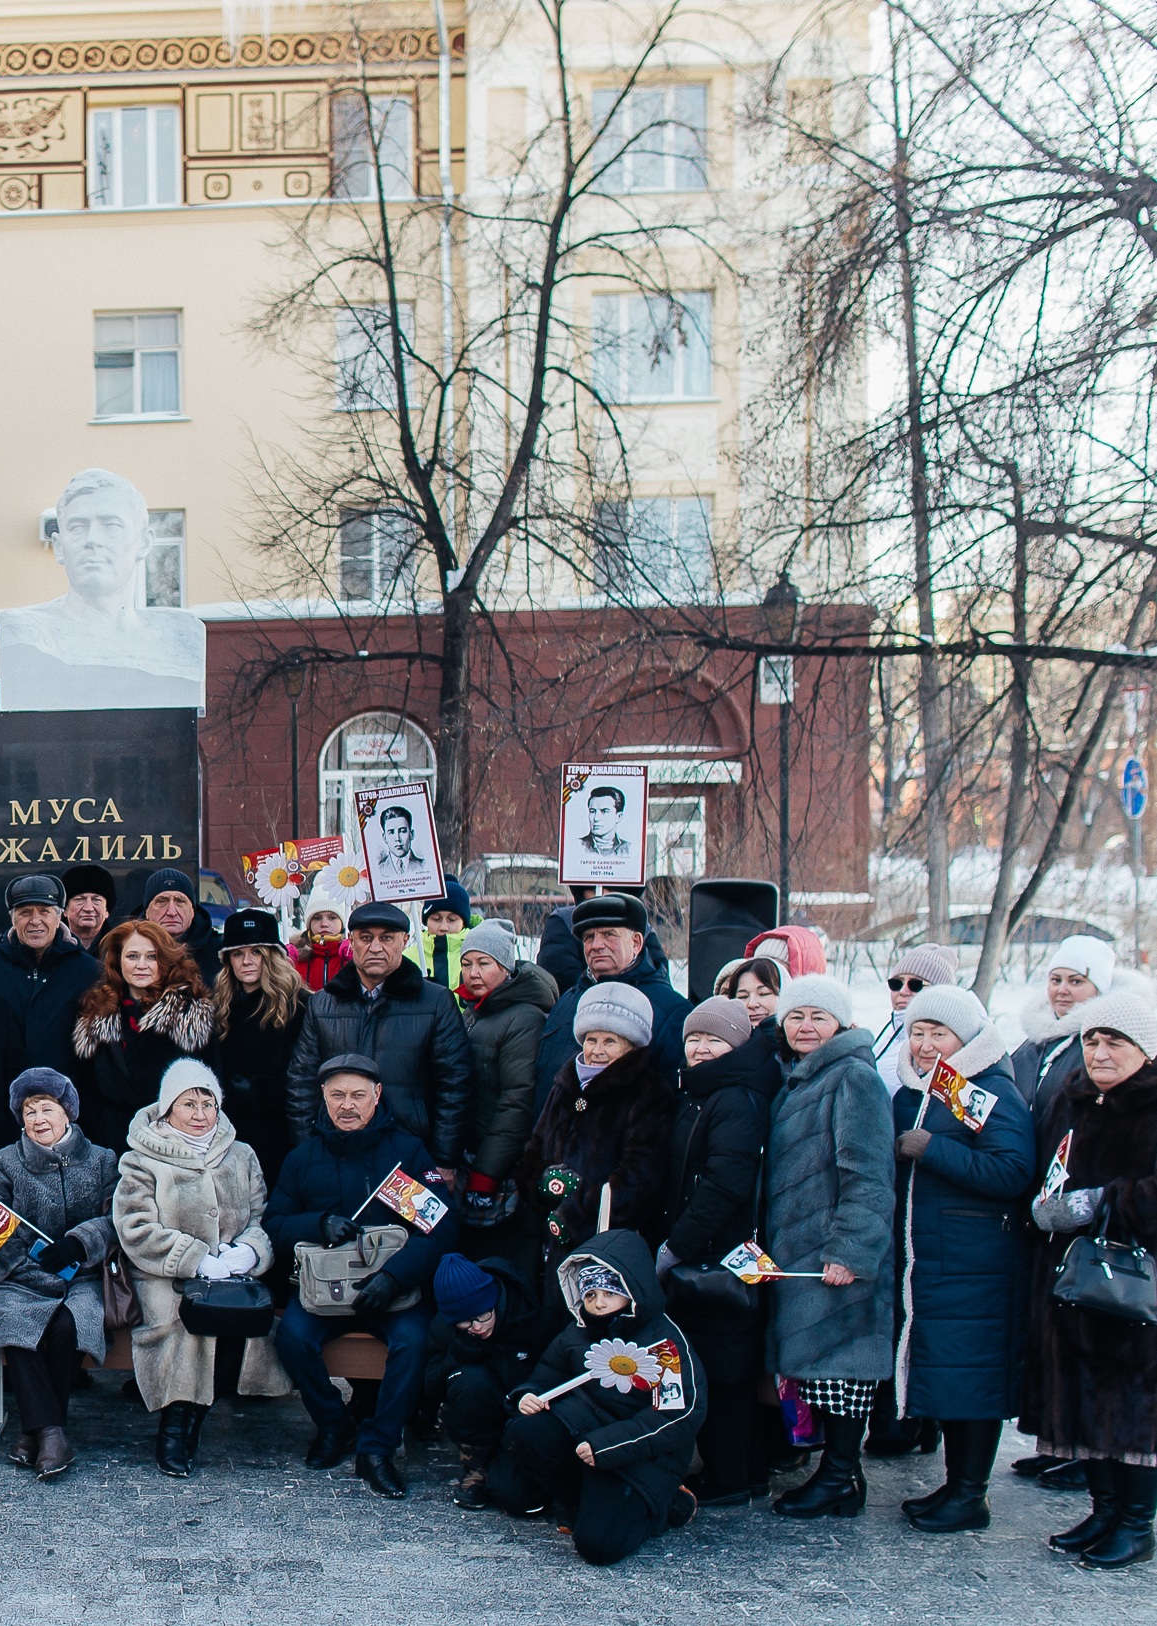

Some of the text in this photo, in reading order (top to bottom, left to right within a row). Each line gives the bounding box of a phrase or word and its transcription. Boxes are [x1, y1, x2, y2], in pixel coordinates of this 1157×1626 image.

[567, 765, 644, 776] ГЕРОИ-ДЖАЛИЛОВЦЫ
[358, 784, 424, 801] ГЕРОИ-ДЖАЛИЛОВЦЫ
[9, 798, 124, 826] МУСА
[936, 1065, 959, 1090] 120
[386, 1173, 413, 1198] 120
